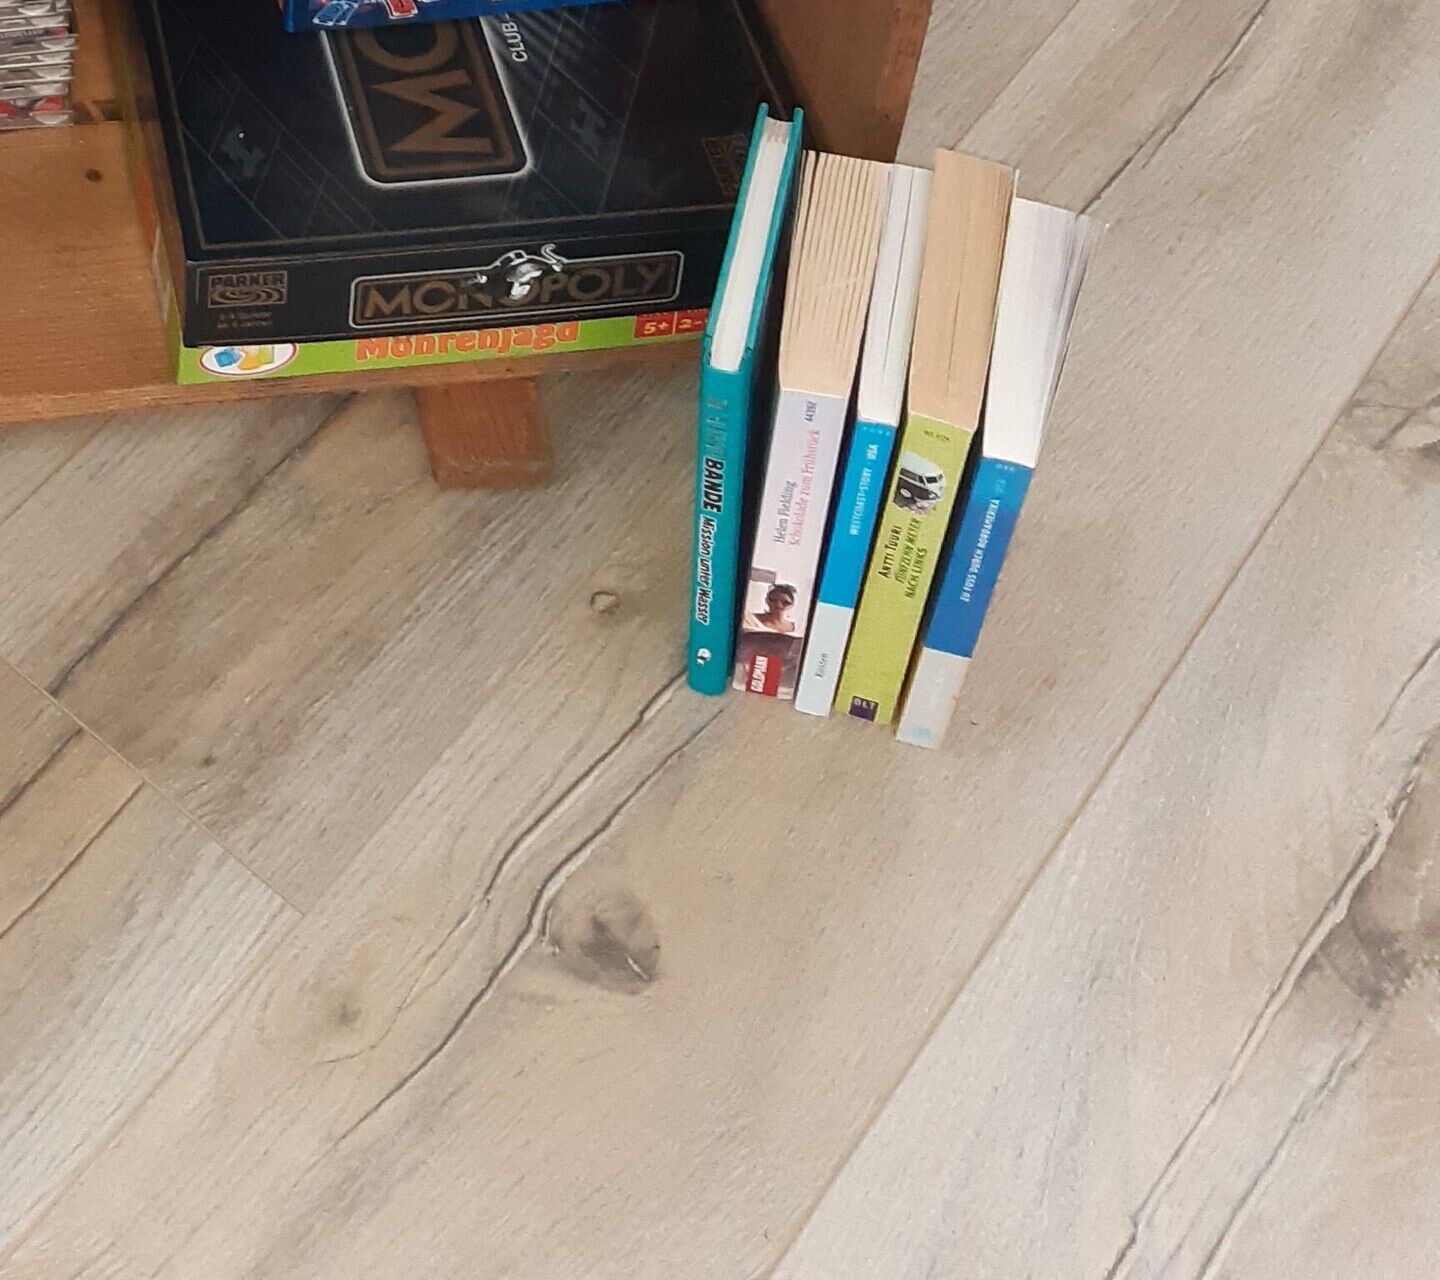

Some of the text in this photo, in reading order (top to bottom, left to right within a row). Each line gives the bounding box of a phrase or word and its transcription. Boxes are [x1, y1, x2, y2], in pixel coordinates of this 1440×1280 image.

[210, 272, 286, 287] PARKER
[643, 320, 669, 334] 5+
[702, 456, 725, 514] BANDE
[798, 476, 812, 496] zum
[850, 467, 871, 536] WESTCOAST-STORY
[773, 479, 797, 544] Helen Fielding
[790, 497, 810, 547] Schokolade
[700, 516, 718, 556] Mission
[878, 525, 901, 579] ANTTI TUURI
[698, 557, 714, 586] unter
[905, 547, 928, 598] NACH LINKS
[967, 549, 984, 573] DURCH
[695, 586, 712, 626] Wasser
